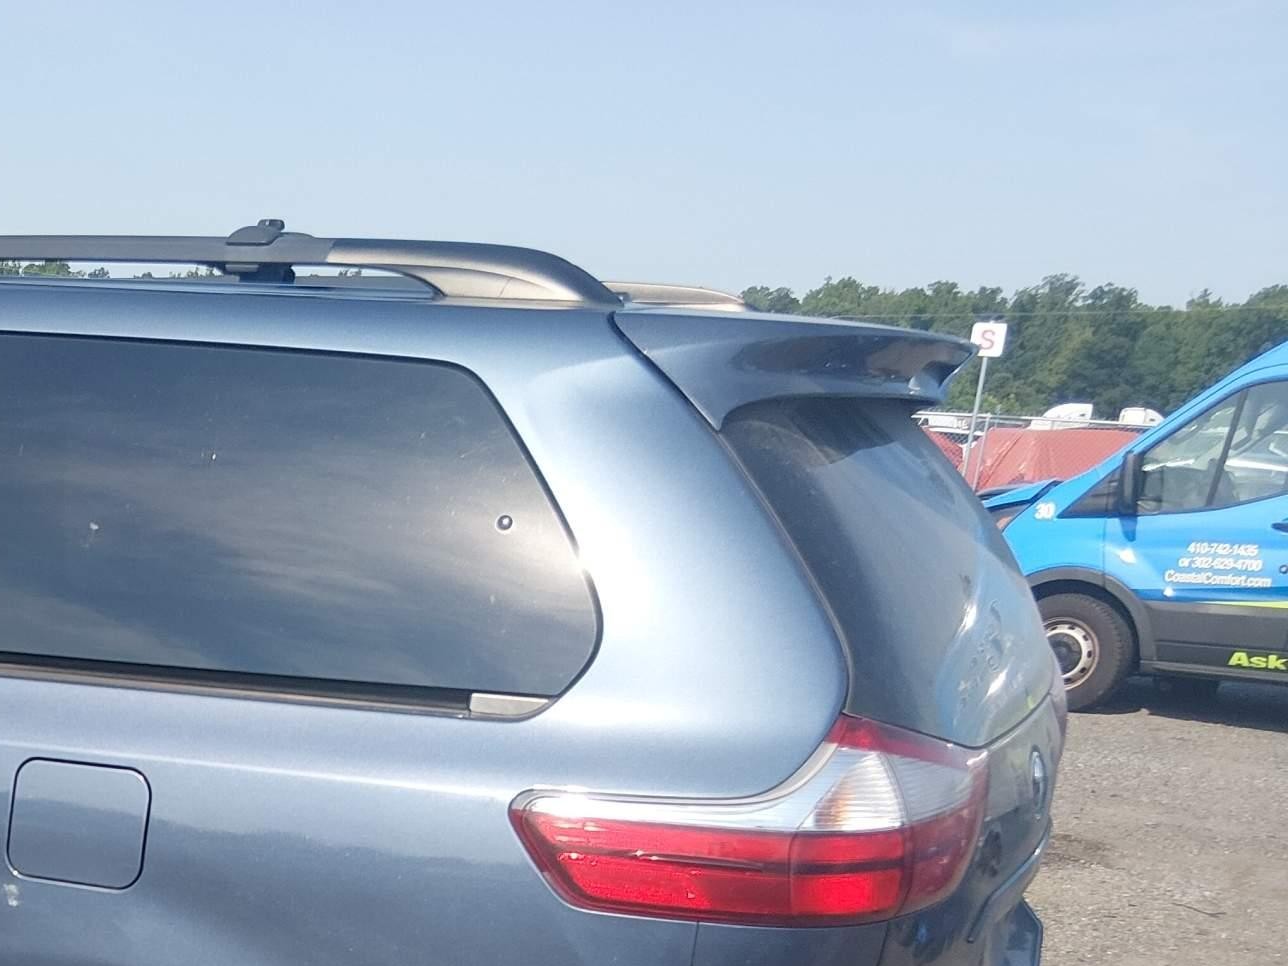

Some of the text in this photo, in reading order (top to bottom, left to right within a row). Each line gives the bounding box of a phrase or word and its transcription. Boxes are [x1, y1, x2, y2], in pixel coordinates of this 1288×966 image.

[981, 329, 996, 350] S
[1034, 502, 1056, 519] 30
[1178, 557, 1192, 568] or
[1164, 569, 1272, 587] CoastalComfort.com
[1227, 651, 1288, 670] Ask
